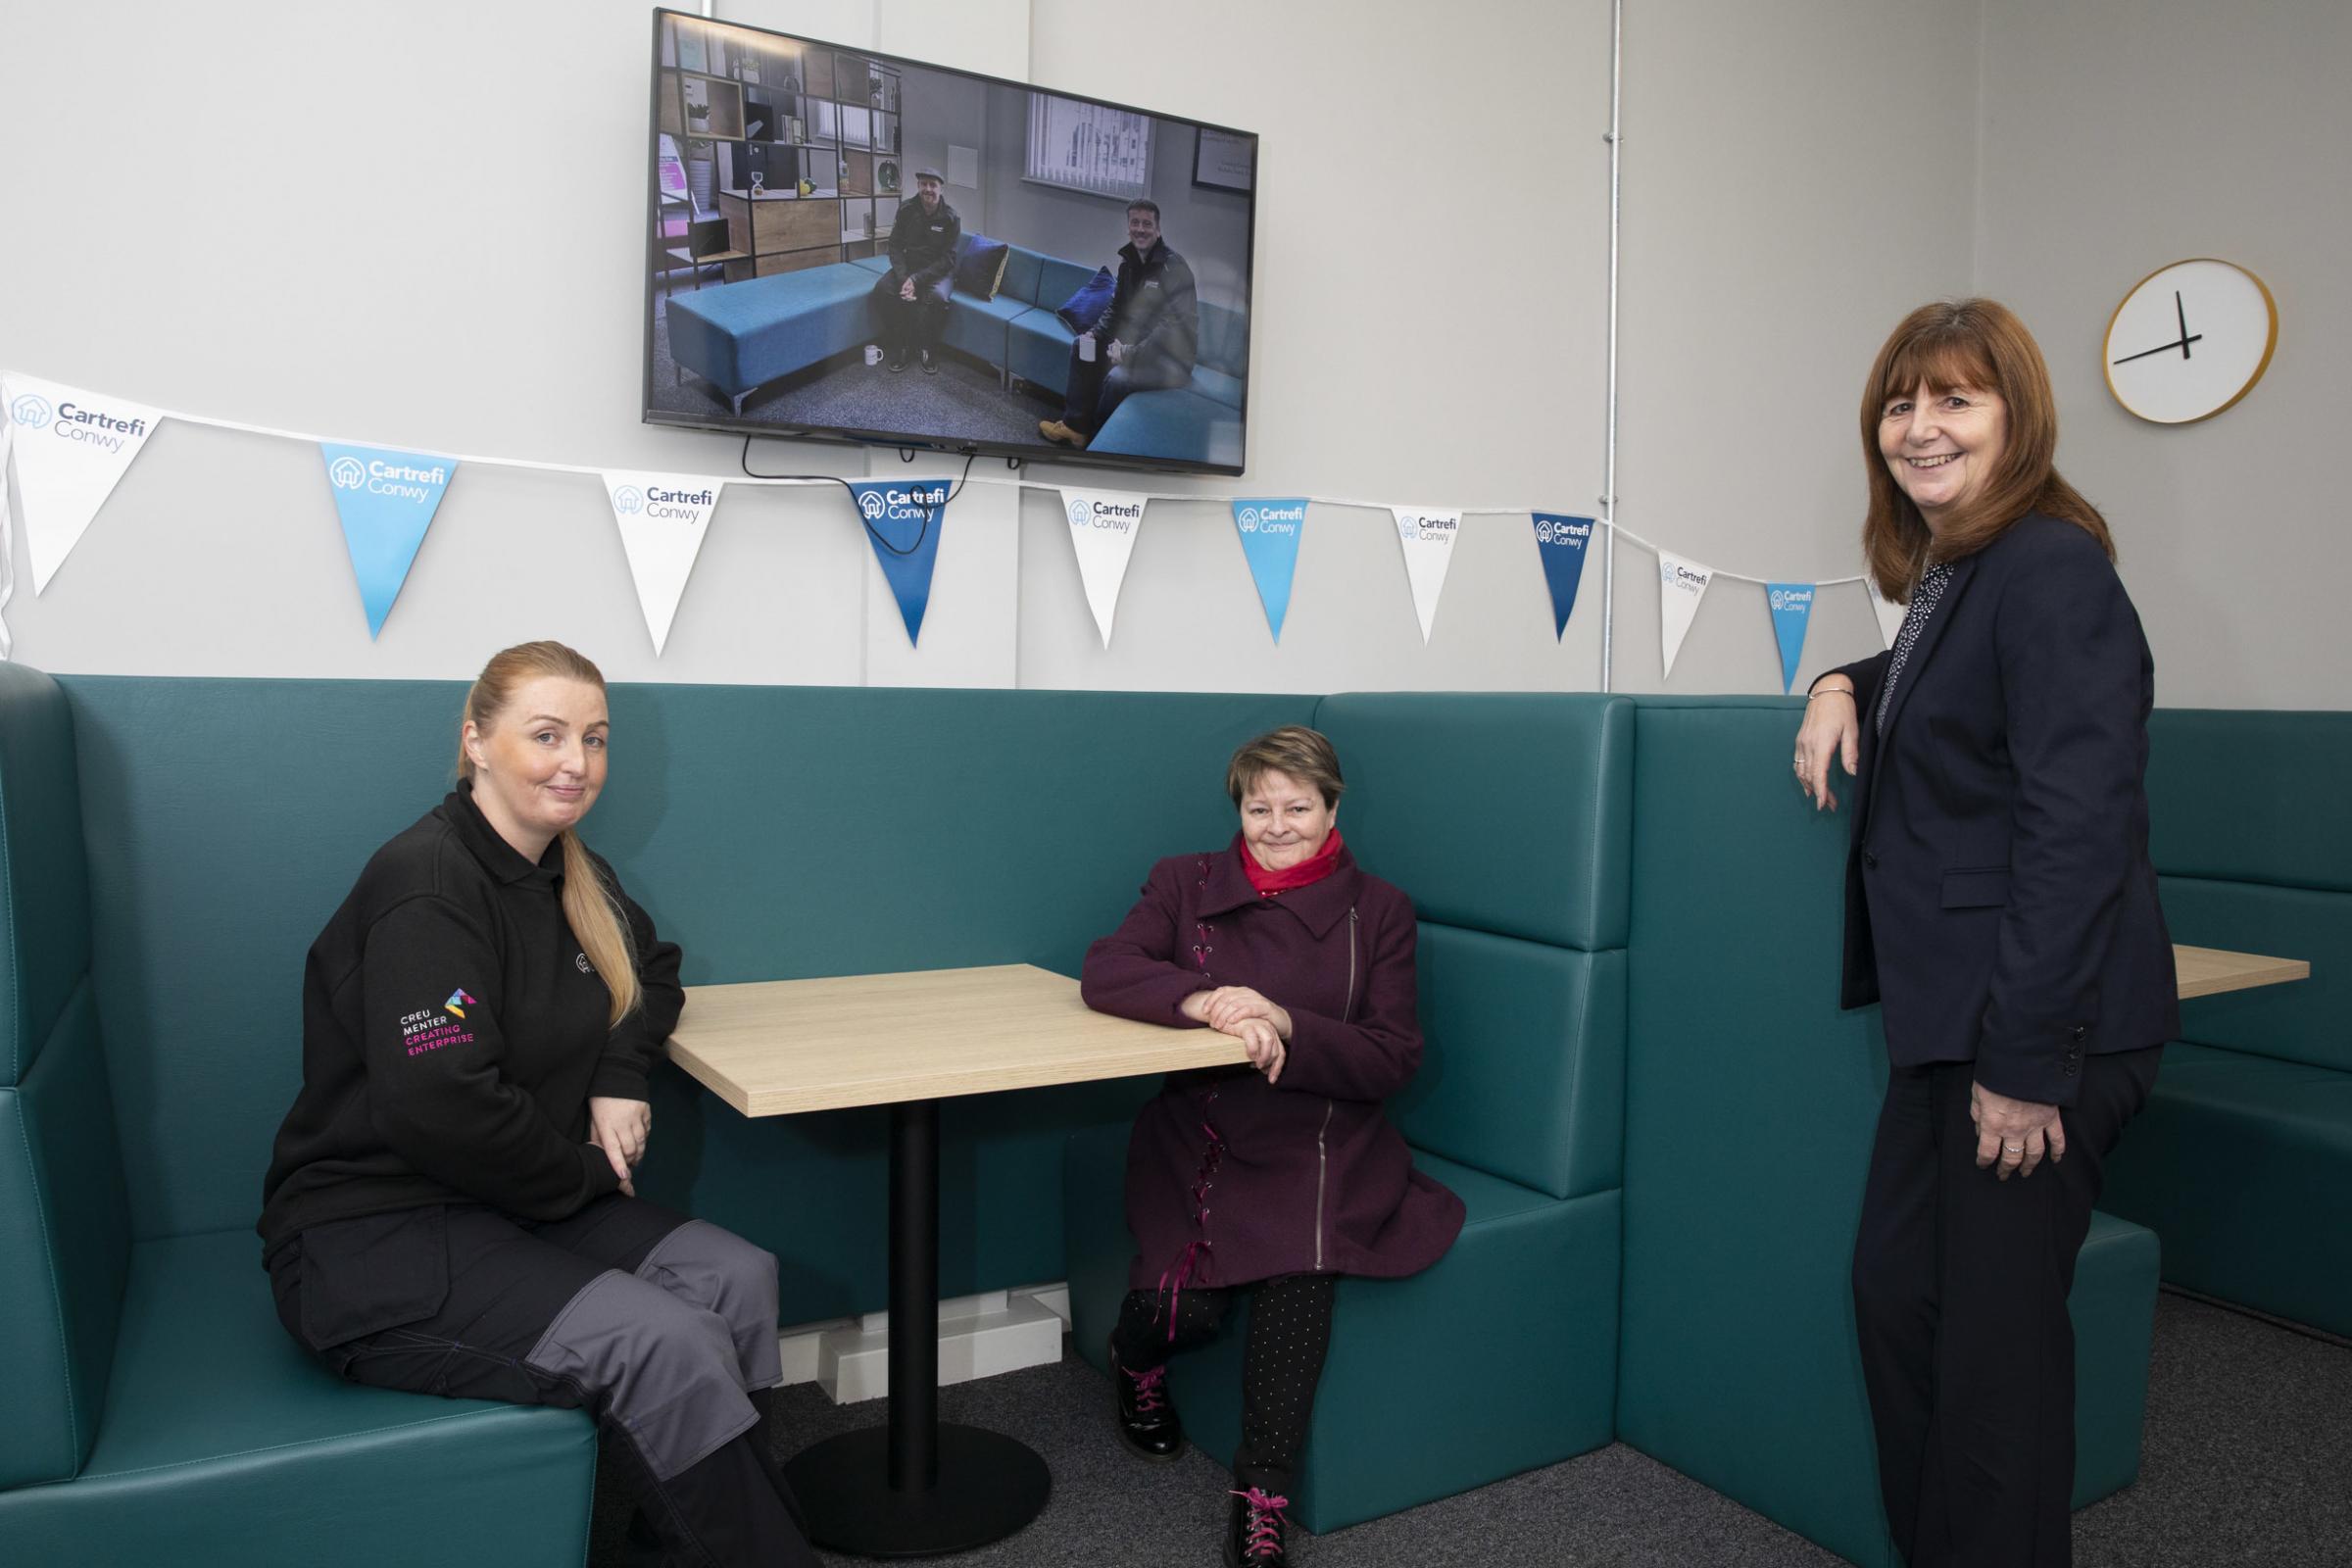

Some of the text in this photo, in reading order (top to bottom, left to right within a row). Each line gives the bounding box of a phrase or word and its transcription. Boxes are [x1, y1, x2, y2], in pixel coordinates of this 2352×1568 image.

[58, 403, 146, 437] Cartrefi
[54, 420, 124, 454] Conwy
[368, 461, 444, 485] Cartrefi
[368, 477, 428, 502] Conwy
[647, 487, 712, 506] Cartrefi
[647, 503, 700, 524] Conwy
[888, 505, 934, 521] Conwy
[1093, 502, 1140, 517] Cartrefi
[1260, 508, 1302, 520] Cartrefi
[1093, 516, 1131, 534] Conwy
[1260, 521, 1296, 536] Conwy
[1419, 517, 1456, 530] Cartrefi
[1554, 522, 1589, 537] Cartrefi
[1420, 529, 1449, 544] Conwy
[1554, 534, 1583, 550] Conwy
[1677, 566, 1707, 586] Cartrefi
[1676, 577, 1699, 596] Conwy
[1784, 590, 1811, 601] Cartrefi
[1784, 601, 1806, 613] Conwy
[400, 1009, 430, 1025] CREU
[403, 1015, 447, 1036] MENTER
[405, 1024, 461, 1046] CREATING
[408, 1034, 474, 1055] ENTERPRISE
